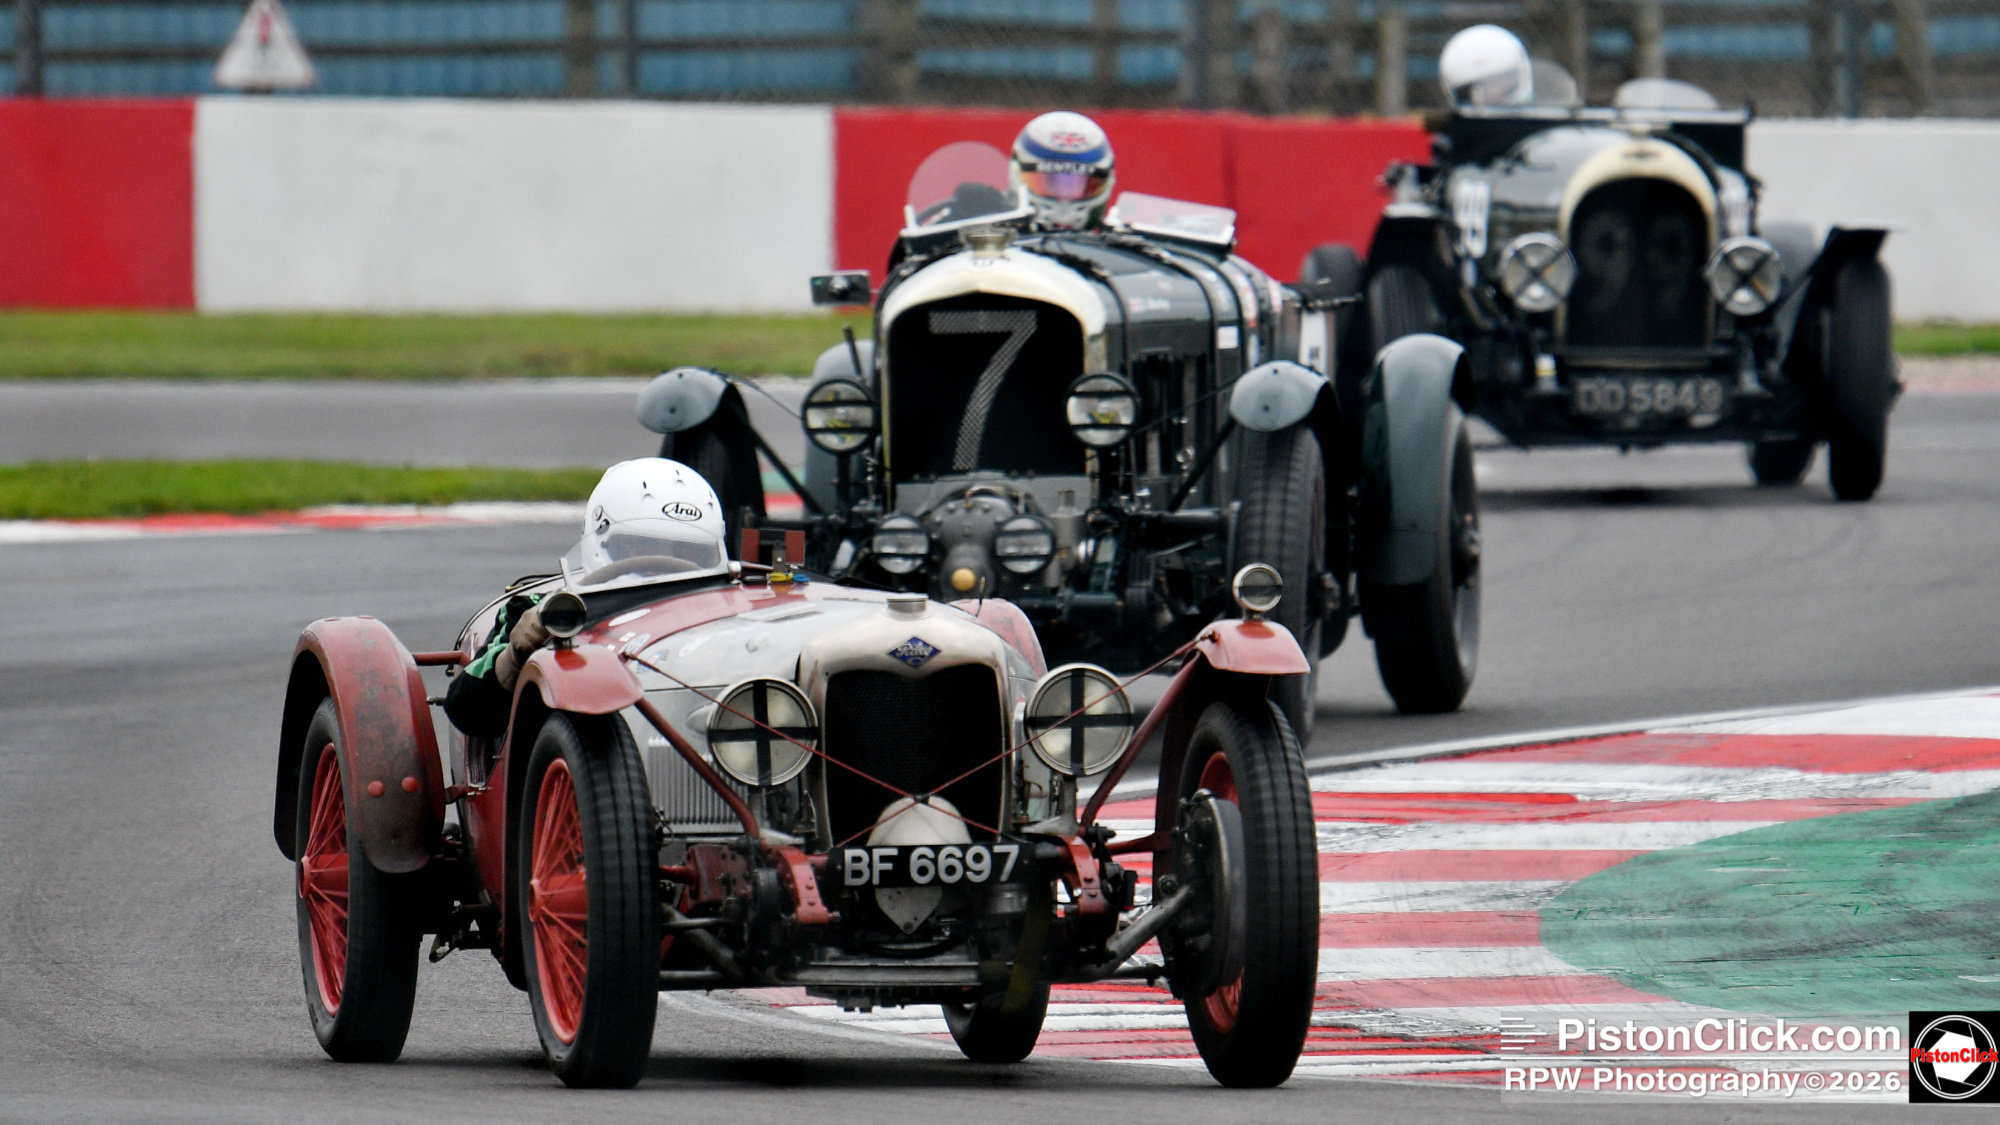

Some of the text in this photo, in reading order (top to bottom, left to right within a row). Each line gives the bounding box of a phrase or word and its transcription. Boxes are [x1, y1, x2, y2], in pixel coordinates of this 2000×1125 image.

[1036, 161, 1096, 175] BENTLEY
[928, 309, 1037, 471] 7
[665, 502, 698, 517] Arai
[844, 844, 1020, 886] BF 6697
